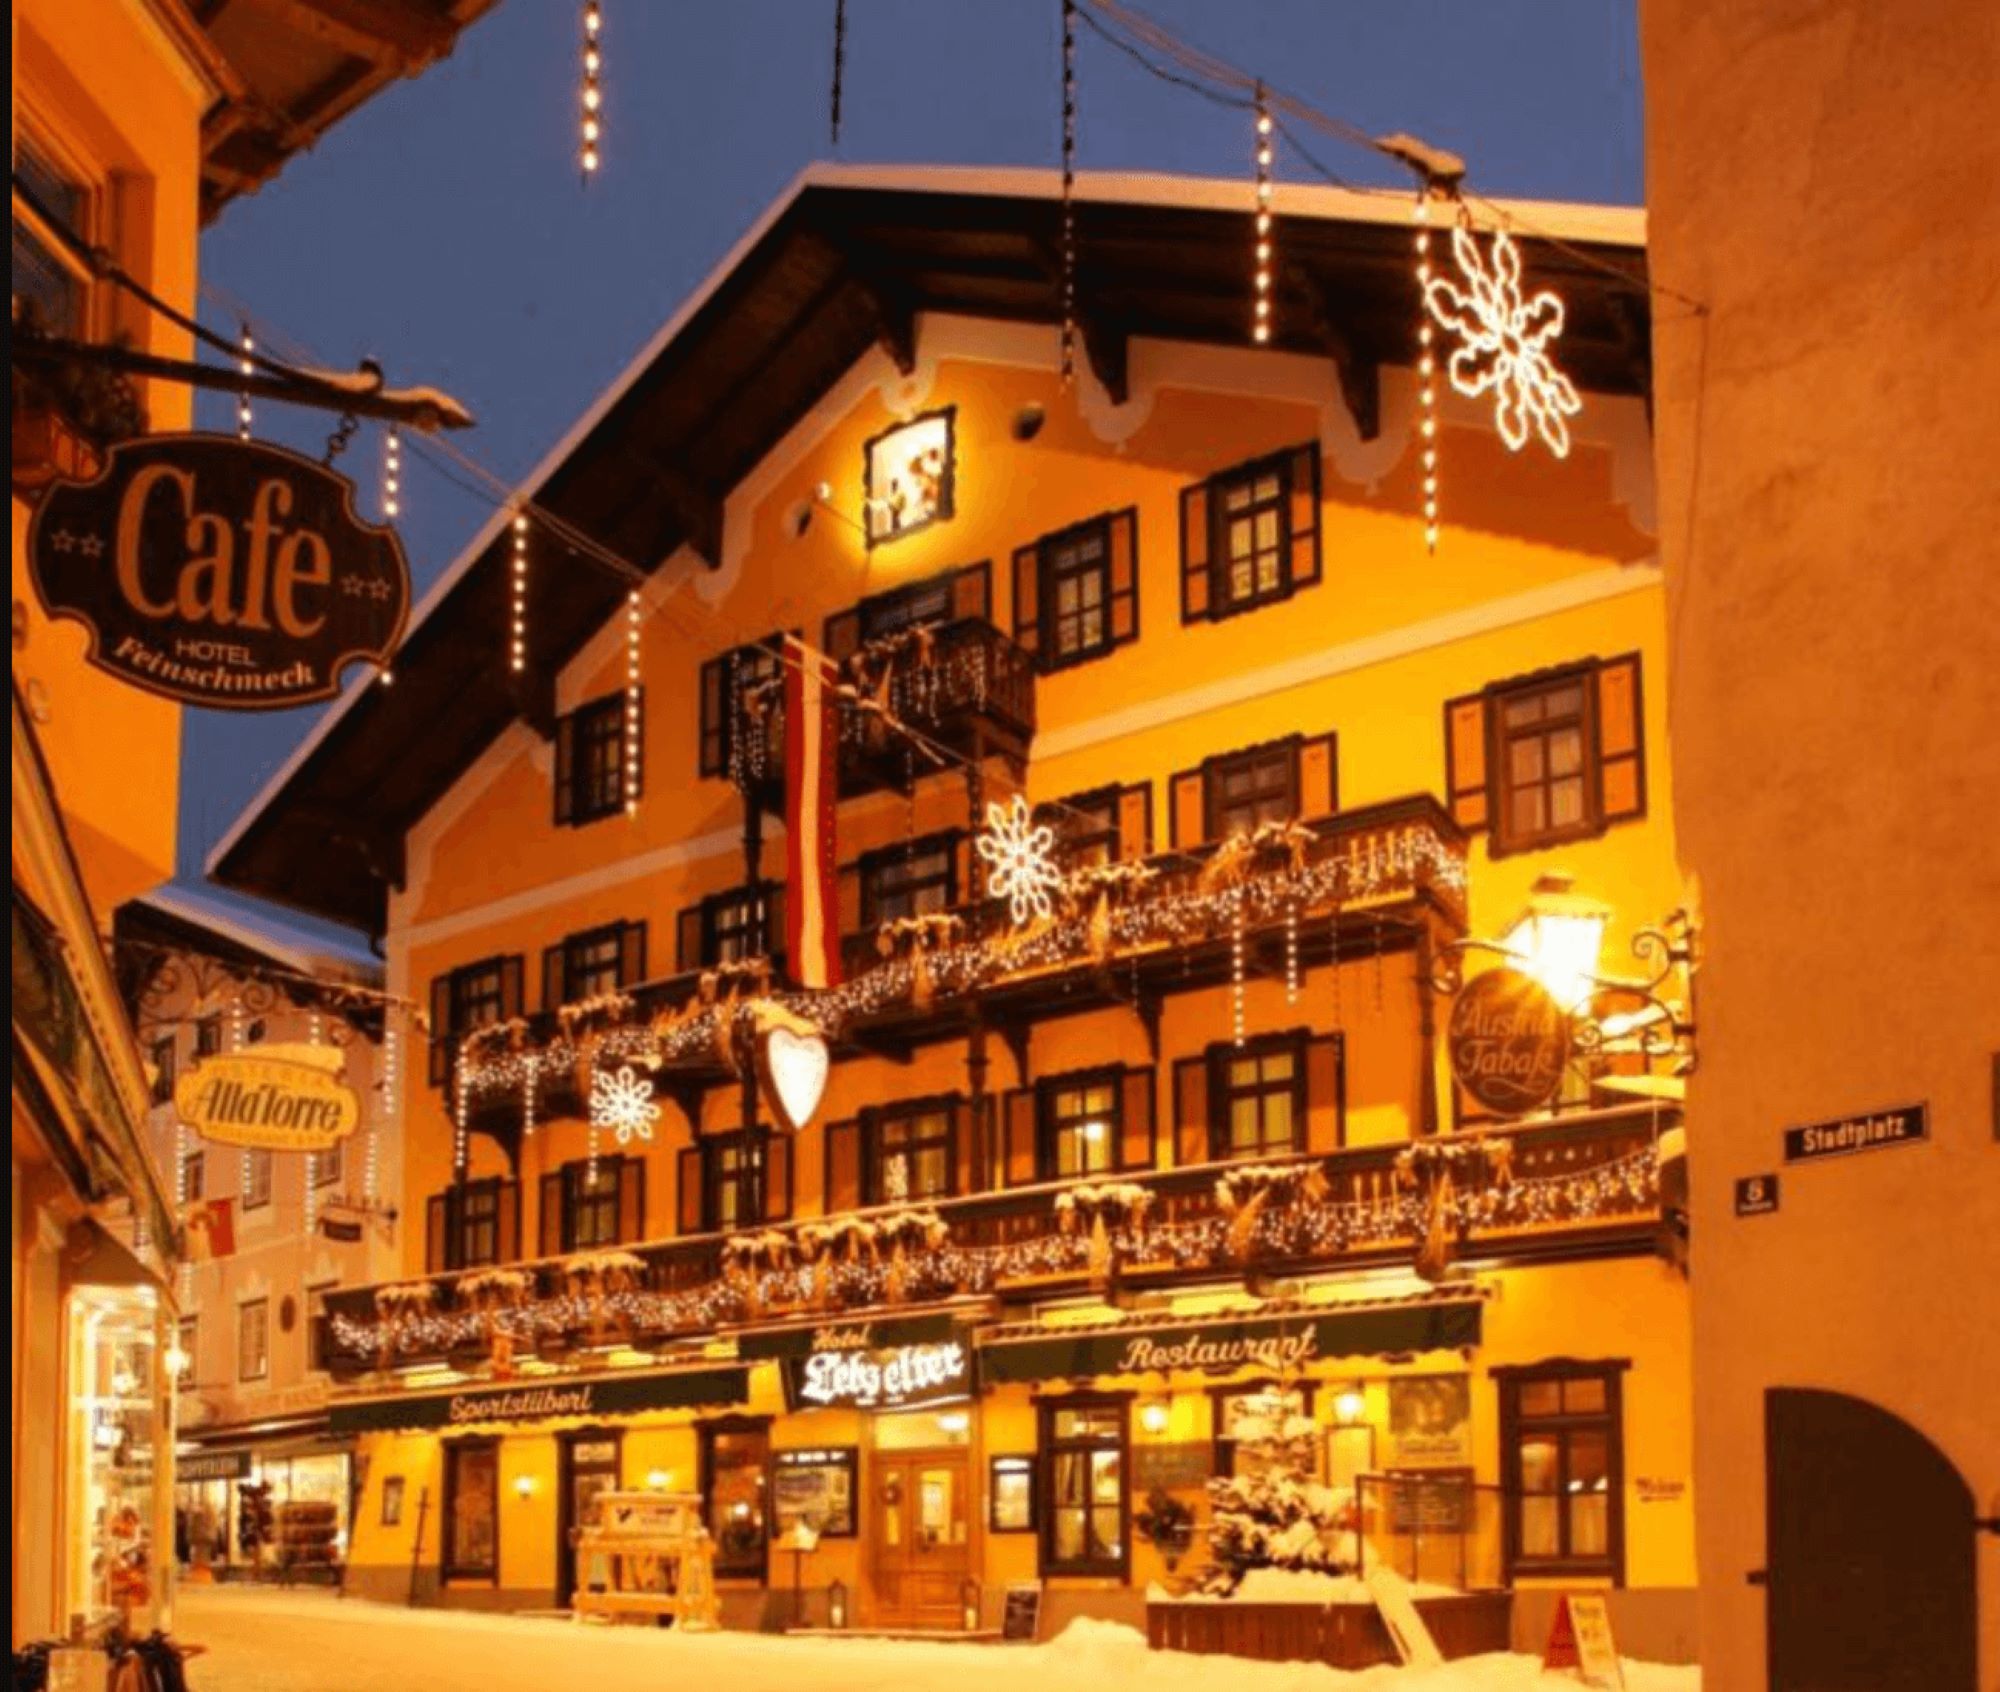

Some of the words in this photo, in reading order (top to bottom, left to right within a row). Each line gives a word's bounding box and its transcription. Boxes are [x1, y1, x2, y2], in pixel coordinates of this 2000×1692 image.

[116, 463, 333, 638] Cafe
[113, 636, 316, 692] Feinschmeck
[175, 638, 256, 667] HOTEL
[1459, 1039, 1560, 1086] Tabak
[1803, 1114, 1906, 1153] Stadtplatz
[1117, 1323, 1318, 1371] Restaurant
